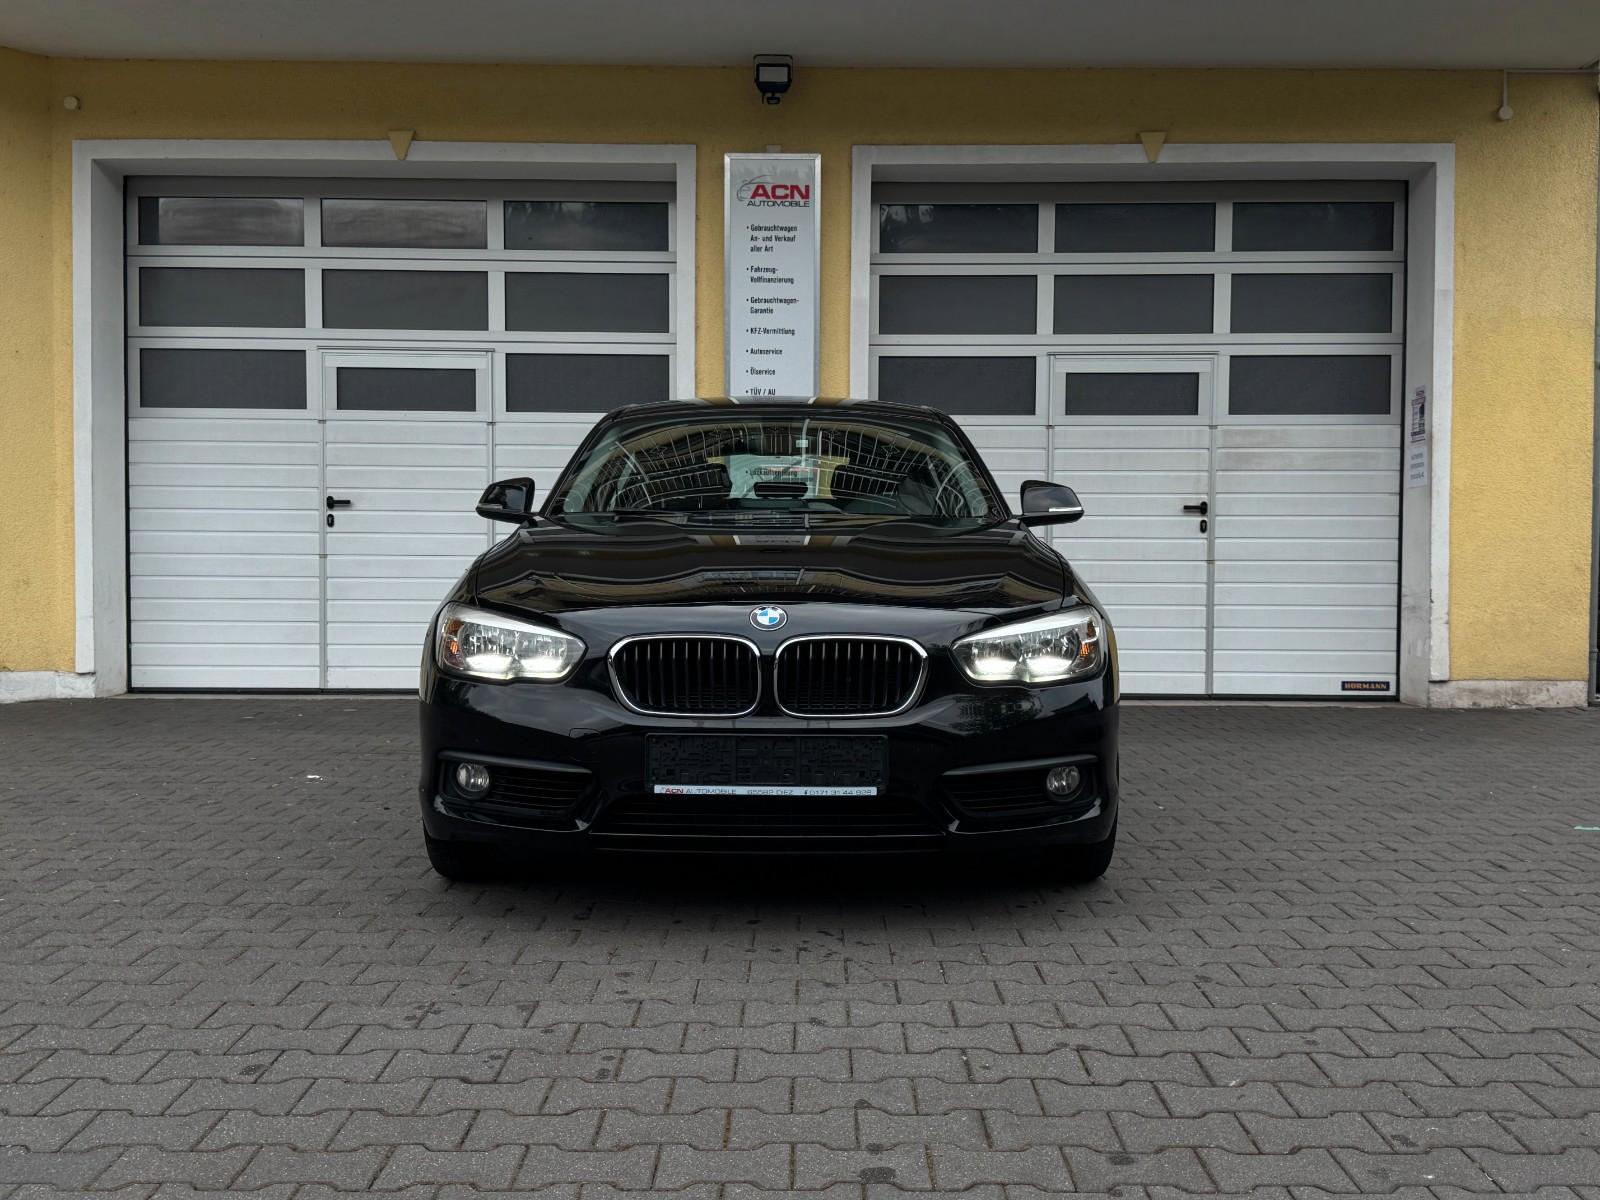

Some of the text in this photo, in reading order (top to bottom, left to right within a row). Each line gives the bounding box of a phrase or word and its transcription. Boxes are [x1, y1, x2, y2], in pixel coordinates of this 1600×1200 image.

[750, 184, 811, 200] ACN
[747, 200, 811, 208] AUTOMOBILE
[750, 224, 798, 233] Gebrauchtwagen
[750, 265, 779, 274] Fahrzeug-
[750, 275, 795, 285] Vollfinanzierung
[750, 296, 800, 306] Gebrauchtwagen-
[750, 306, 774, 314] Garantie
[750, 327, 796, 336] KFZ-Vermittlung
[750, 347, 783, 355] Autoservice
[750, 366, 776, 376] Ölservice
[750, 386, 762, 396] TÜV
[768, 388, 776, 396] AU
